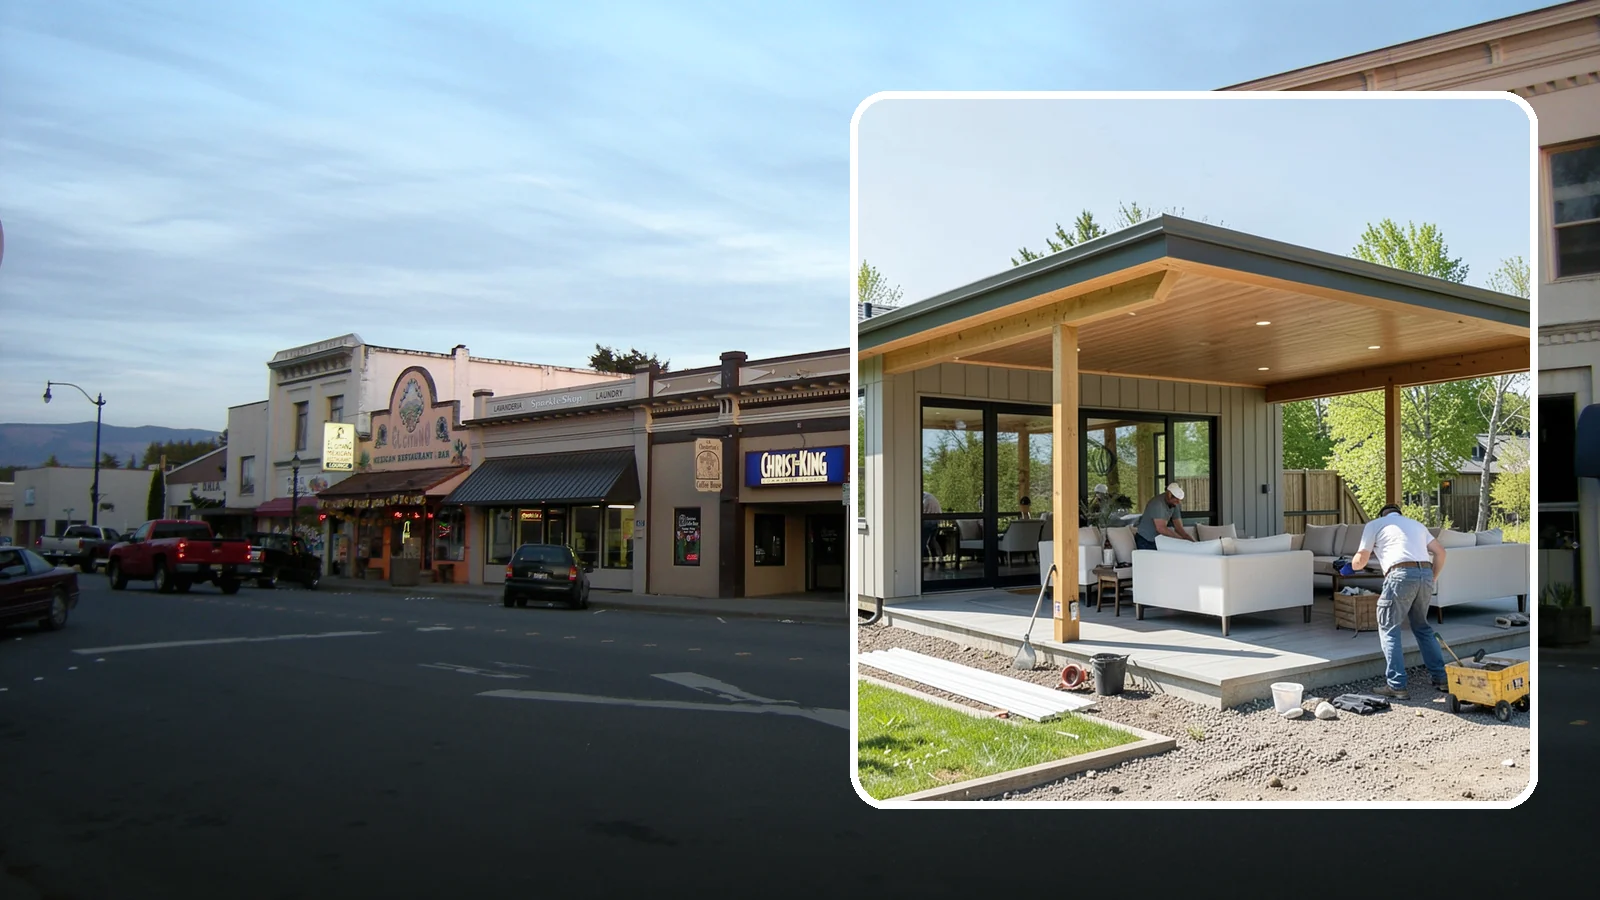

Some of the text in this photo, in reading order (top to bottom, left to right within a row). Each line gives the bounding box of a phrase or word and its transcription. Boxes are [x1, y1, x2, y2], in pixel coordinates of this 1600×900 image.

[531, 394, 582, 408] Sparkle Shop
[595, 388, 624, 400] LAUNDRY
[493, 402, 522, 412] LAVANDERIA
[373, 454, 396, 464] MEXICAN
[397, 451, 434, 462] RESTAURANT
[437, 450, 450, 459] BAR
[761, 450, 827, 478] CHRIST KING
